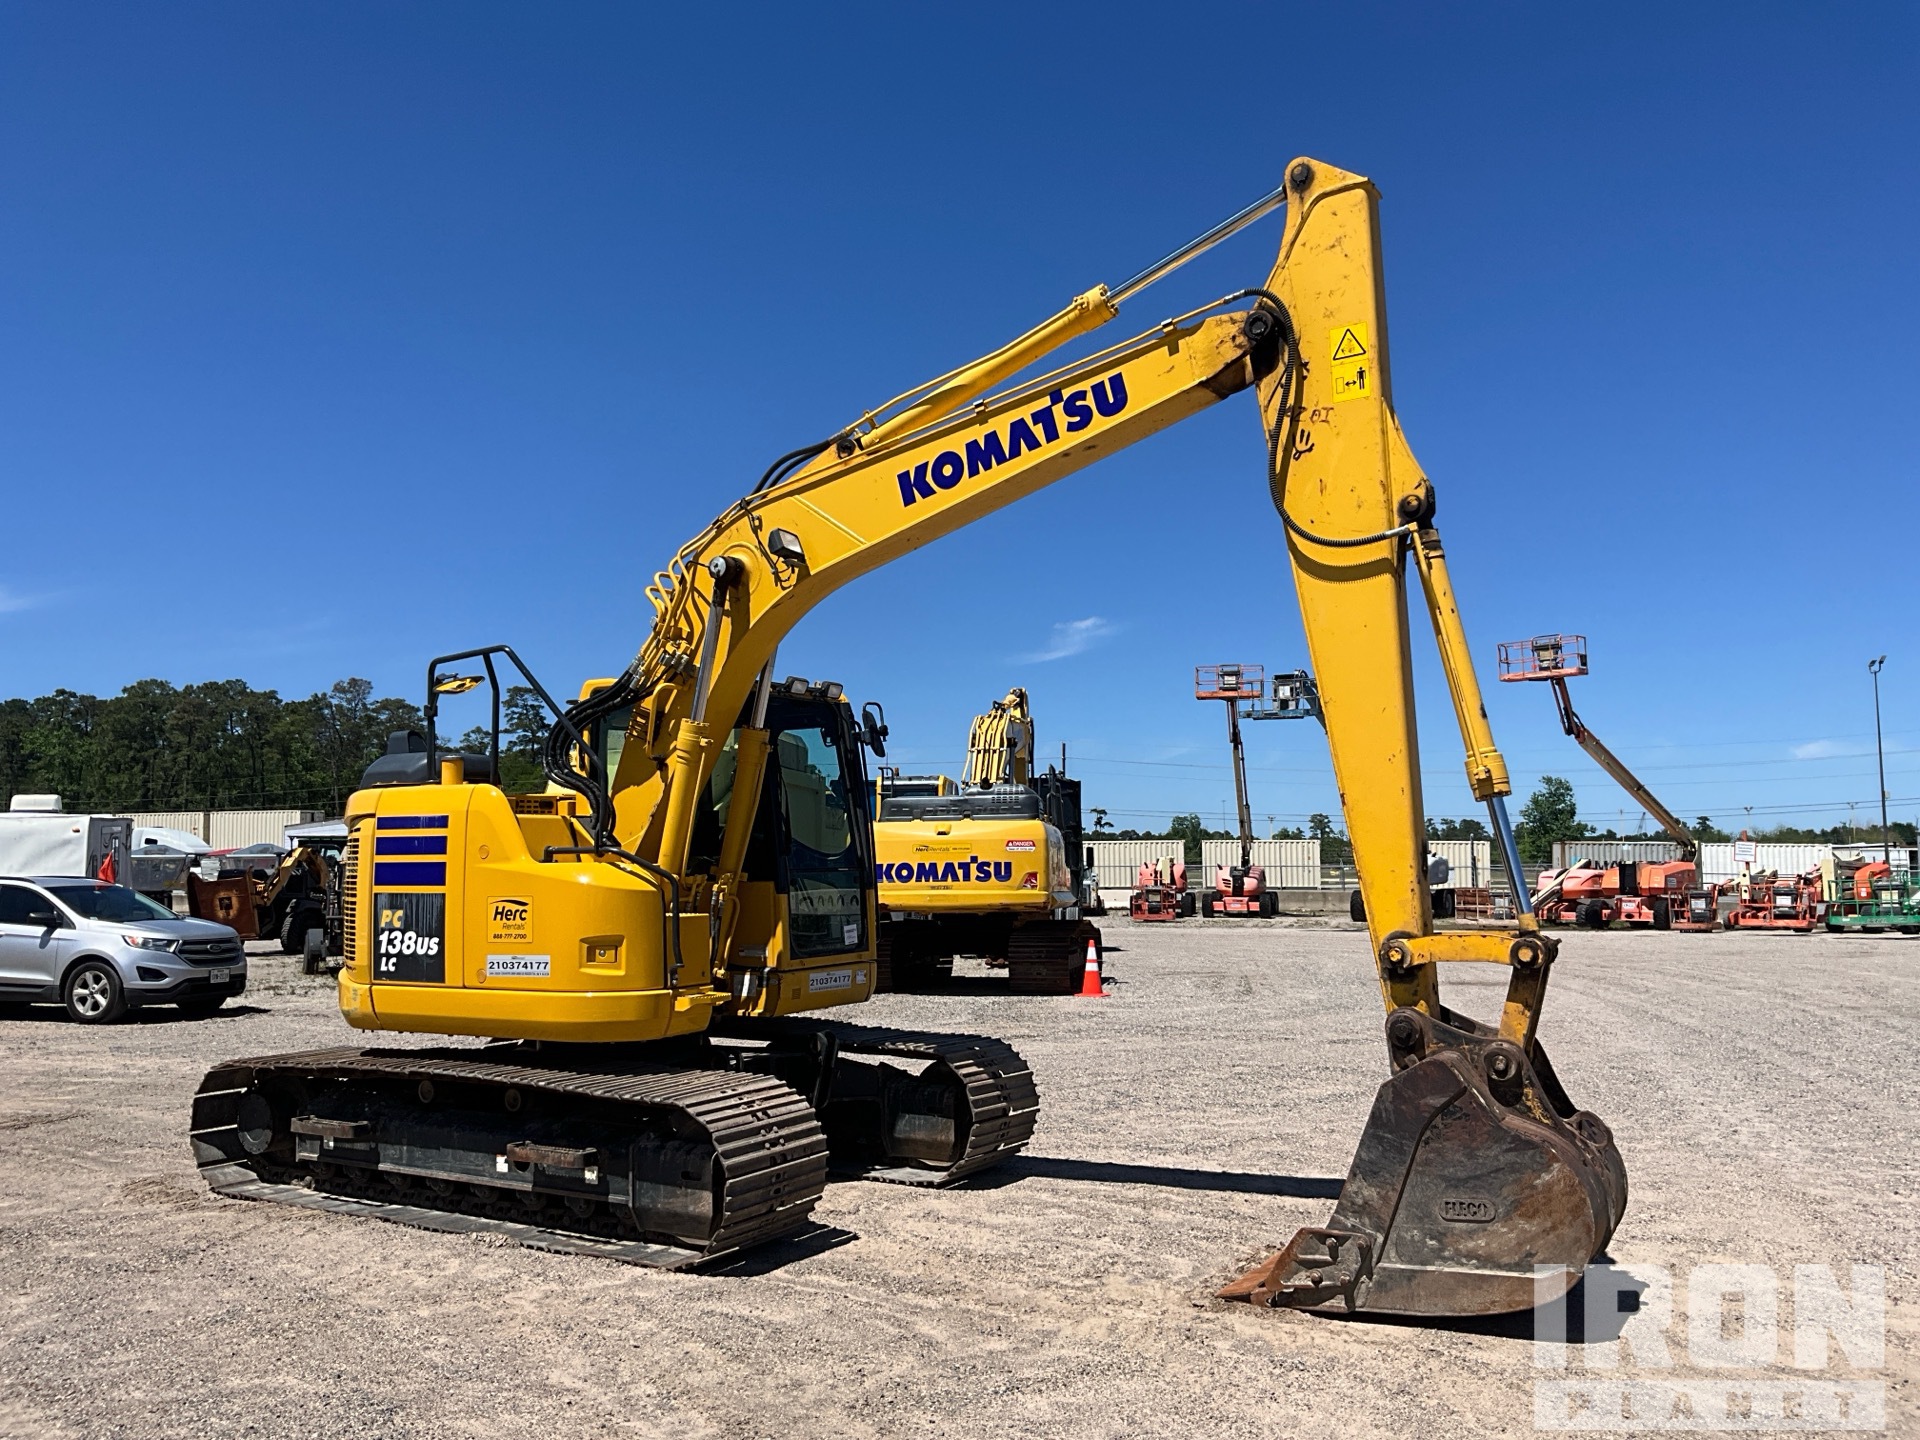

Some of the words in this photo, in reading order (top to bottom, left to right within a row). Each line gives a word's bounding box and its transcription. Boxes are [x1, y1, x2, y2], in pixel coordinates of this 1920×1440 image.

[897, 372, 1128, 507] KOMATSU
[877, 855, 1012, 882] KOMATSU
[380, 909, 404, 928] PC
[493, 905, 528, 921] Herc
[502, 922, 525, 930] Rentals
[380, 957, 397, 972] LC
[488, 961, 549, 970] 210374177
[810, 974, 851, 986] 210374177
